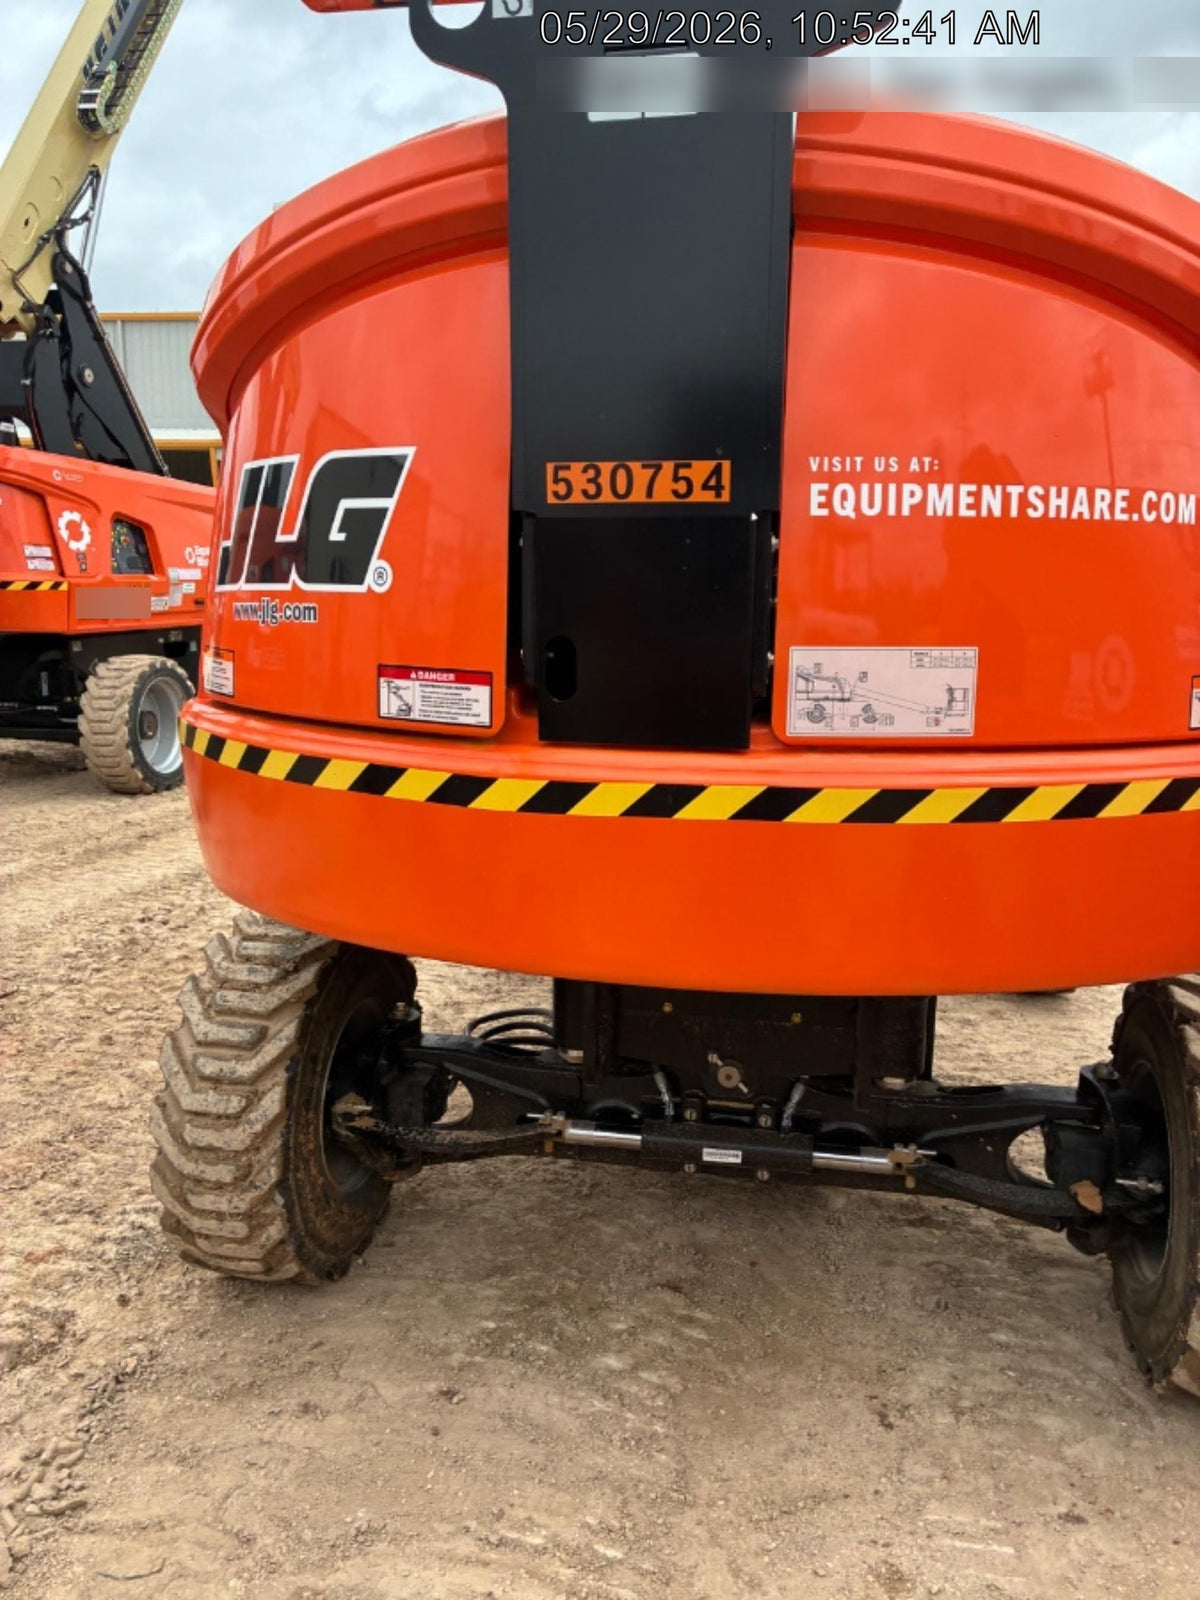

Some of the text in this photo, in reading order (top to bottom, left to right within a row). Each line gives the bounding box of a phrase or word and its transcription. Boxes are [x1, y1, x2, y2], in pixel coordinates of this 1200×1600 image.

[808, 456, 940, 473] VISIT US AT:
[551, 461, 726, 501] 530754
[809, 482, 1197, 526] EQUIPMENTSHARE.COM
[233, 597, 319, 627] www.jlg.com
[417, 670, 456, 682] DANGER
